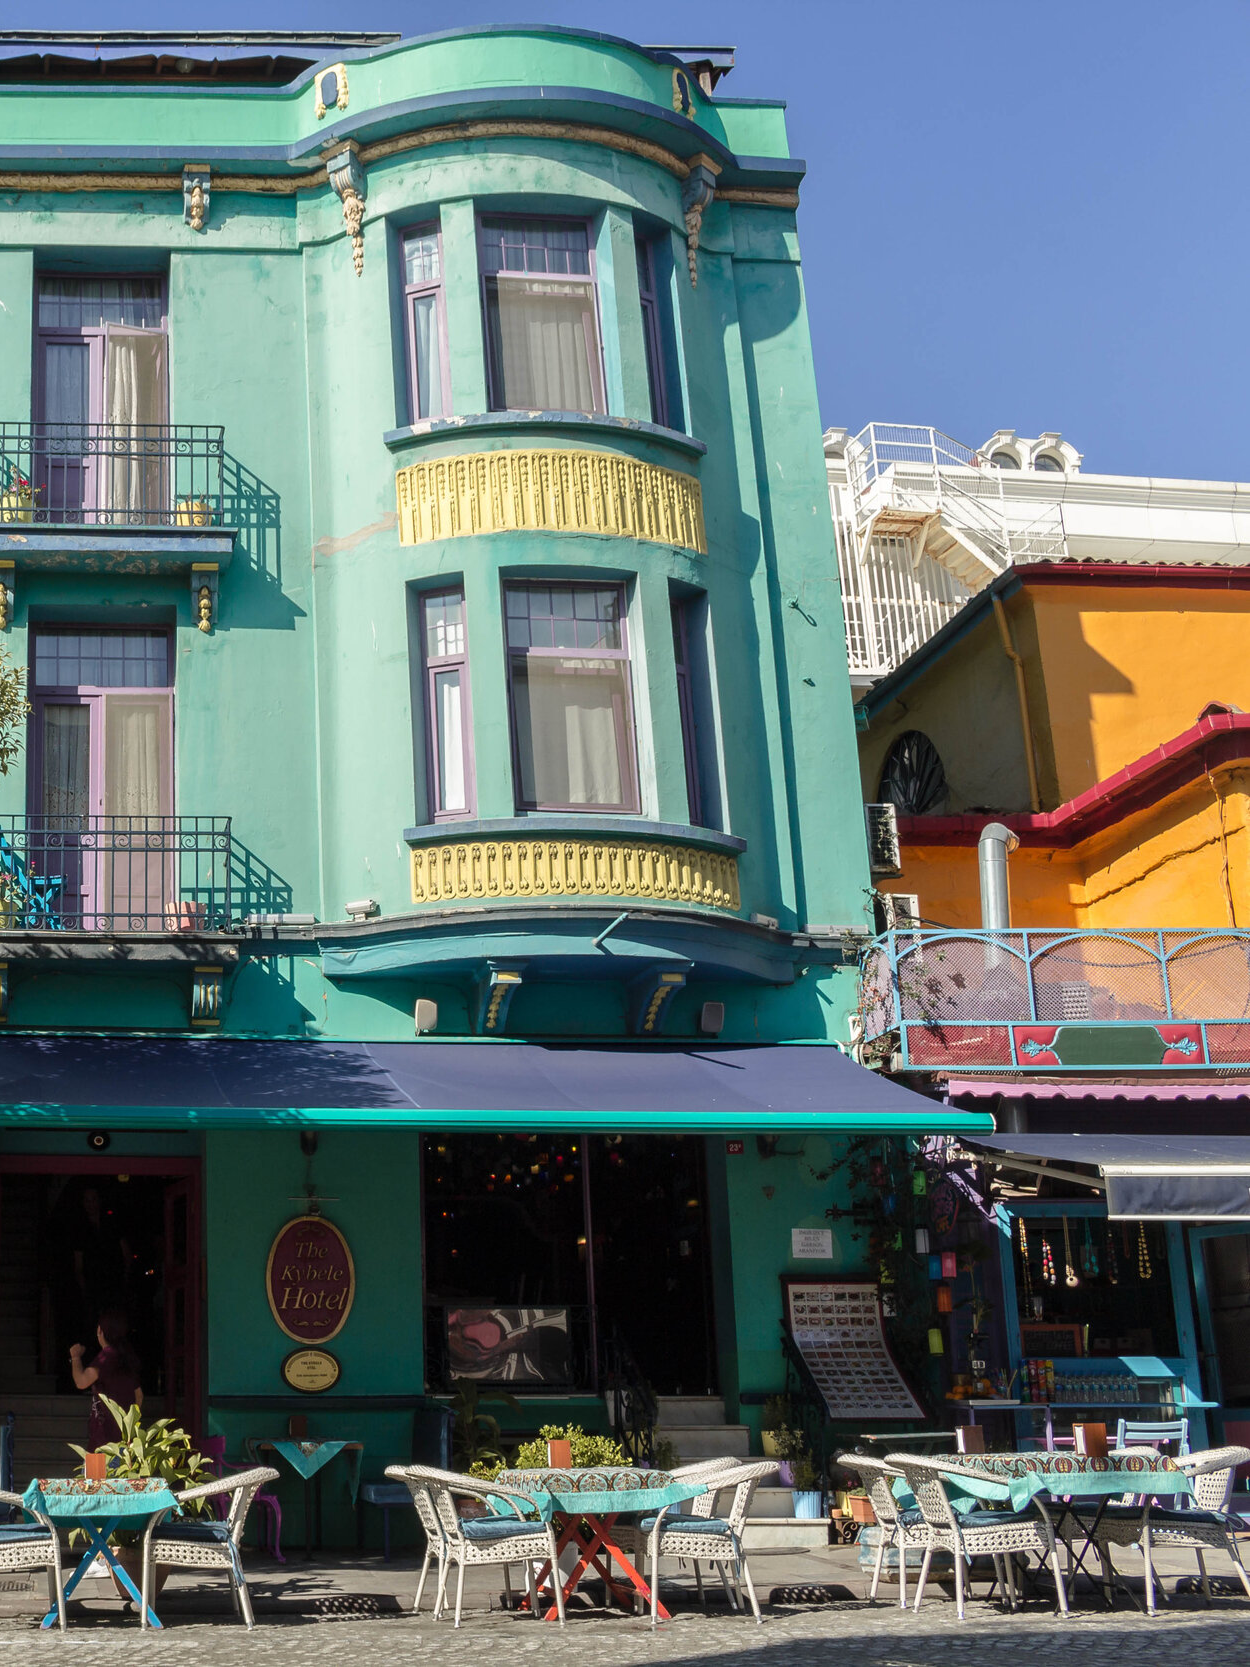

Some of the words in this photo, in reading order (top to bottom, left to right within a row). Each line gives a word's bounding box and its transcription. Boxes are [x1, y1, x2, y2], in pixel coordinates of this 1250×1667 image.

[295, 1241, 328, 1258] The
[281, 1265, 343, 1286] Kybele
[278, 1287, 348, 1311] Hotel
